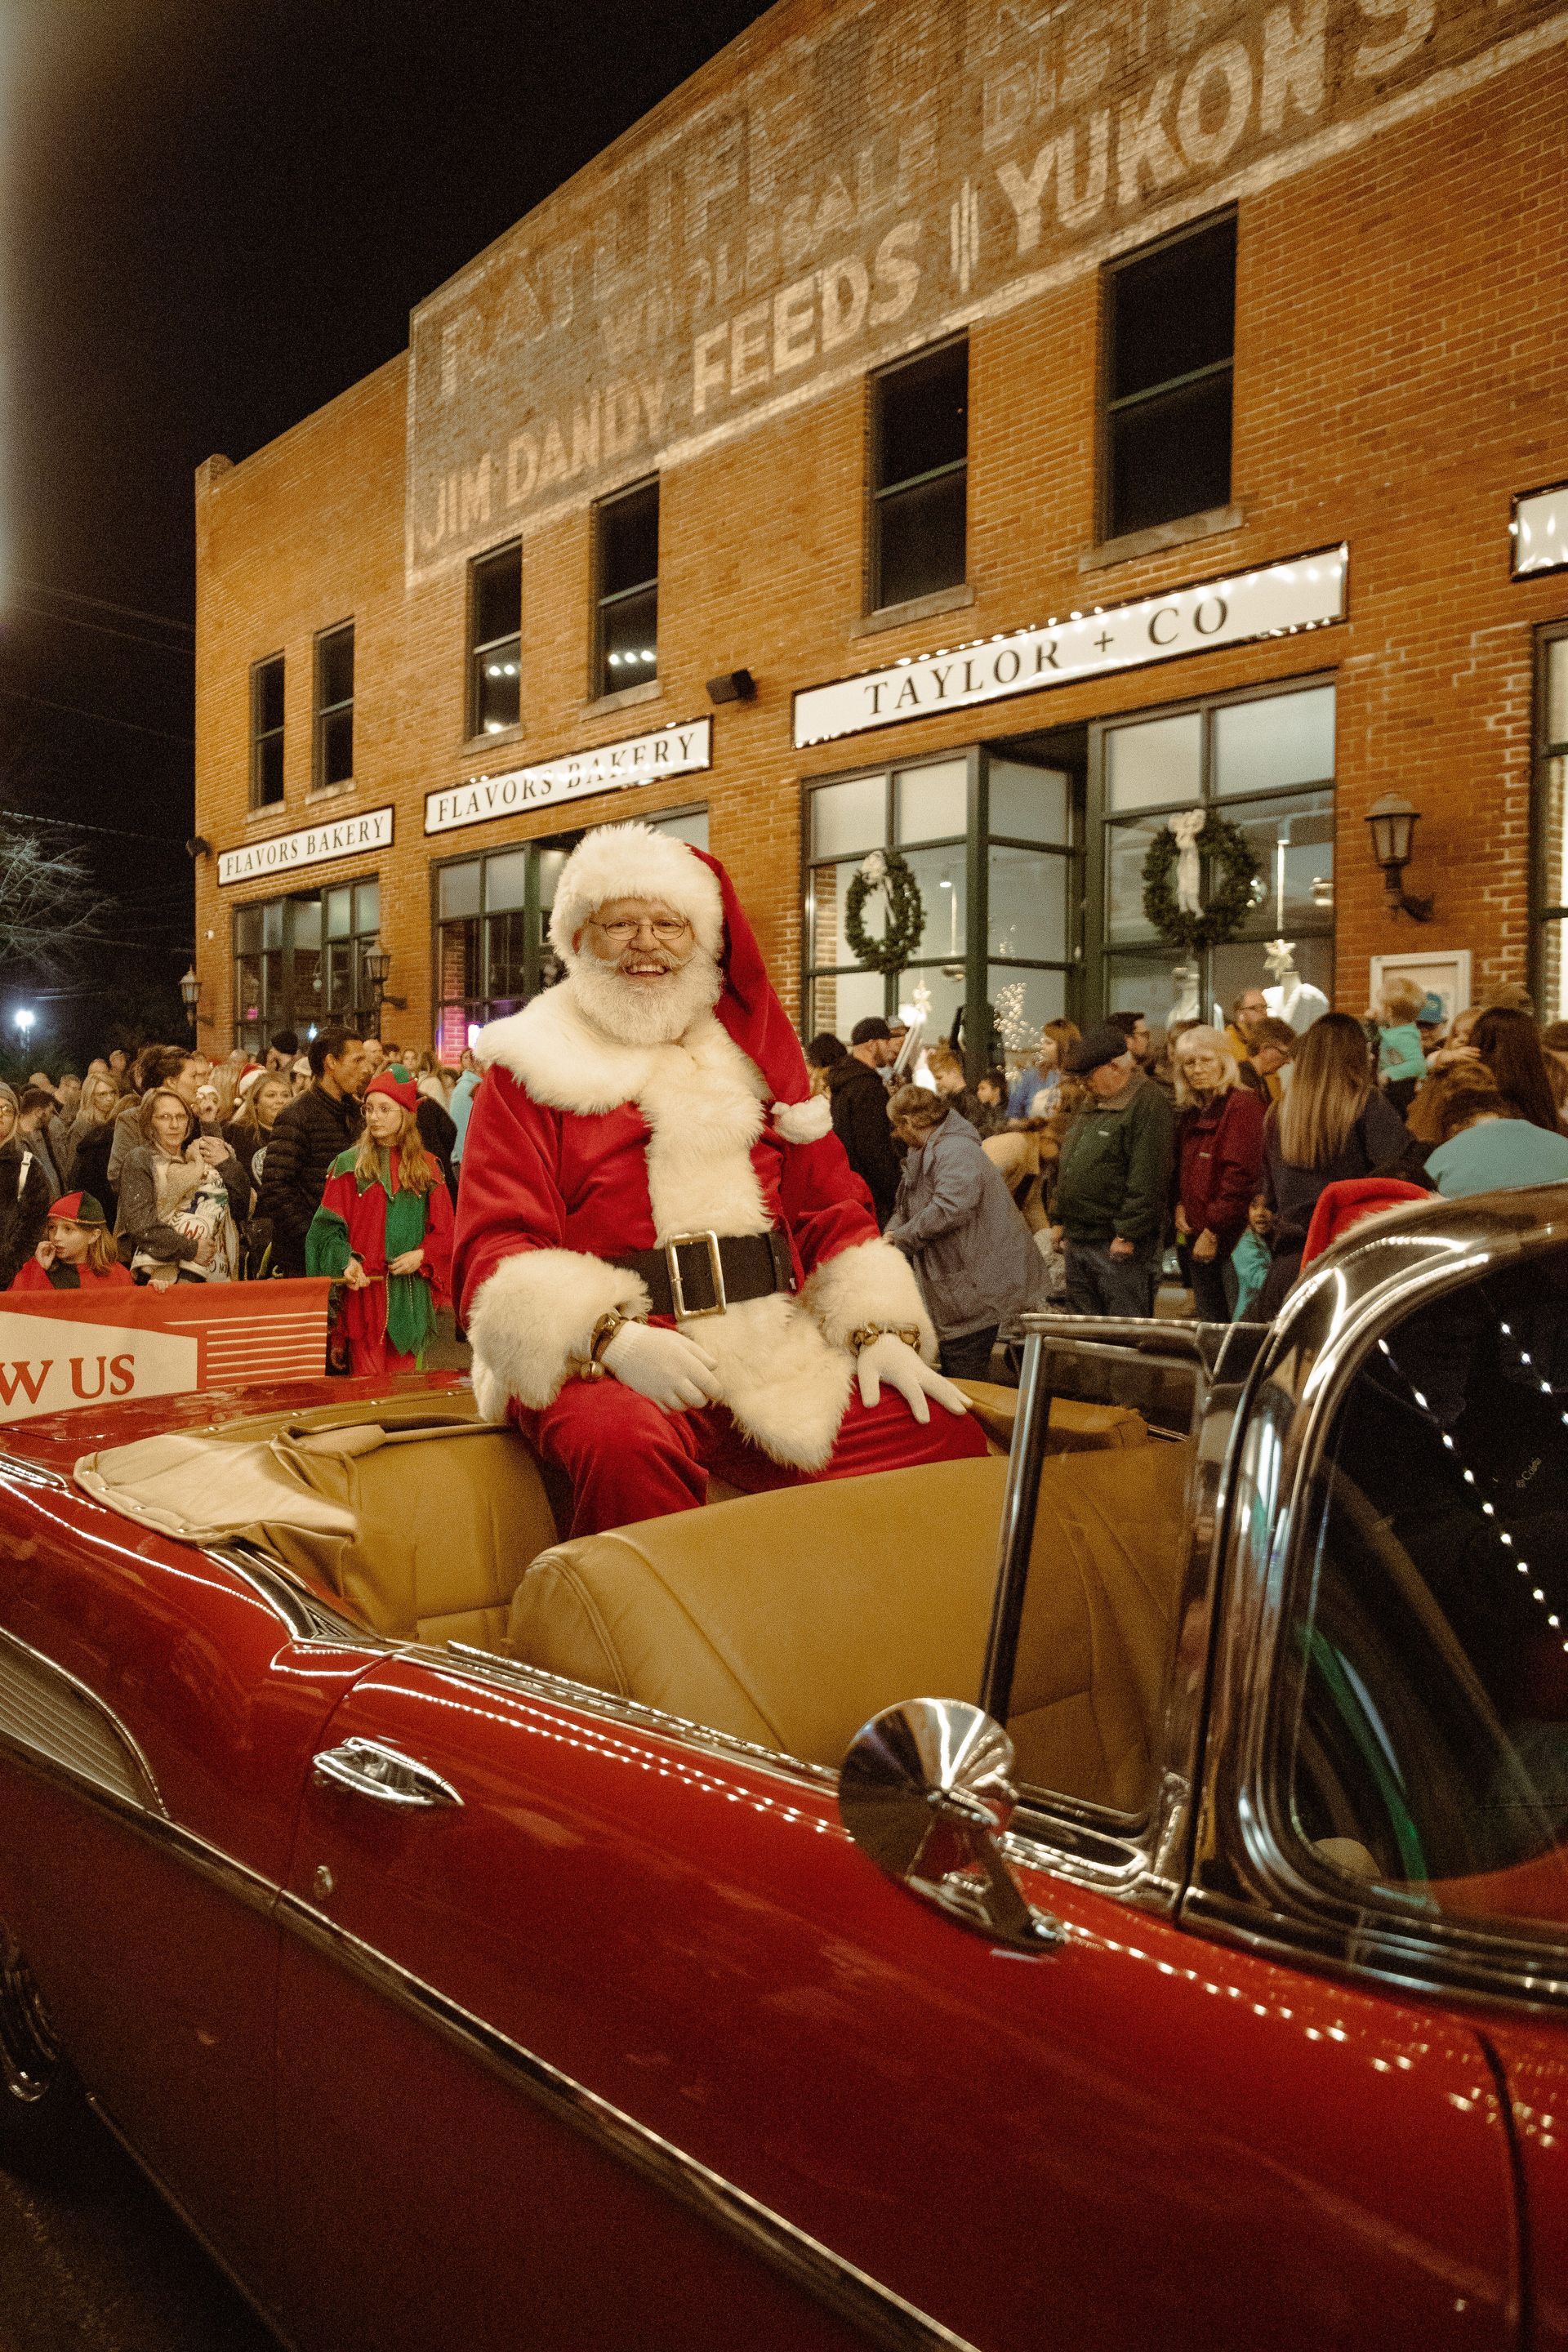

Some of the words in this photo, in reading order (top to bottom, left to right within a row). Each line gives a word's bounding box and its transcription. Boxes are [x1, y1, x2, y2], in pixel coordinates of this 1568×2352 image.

[420, 452, 492, 550] JIM
[506, 376, 666, 508] DANDY
[693, 220, 922, 417] FEEDS
[863, 639, 1062, 715] TAYLOR
[1147, 596, 1227, 646] CO
[437, 775, 553, 823] FLAVORS
[567, 731, 697, 789] BAKERY
[224, 840, 299, 877] FLAVORS
[305, 817, 385, 855] BAKERY
[69, 1353, 135, 1400] US
